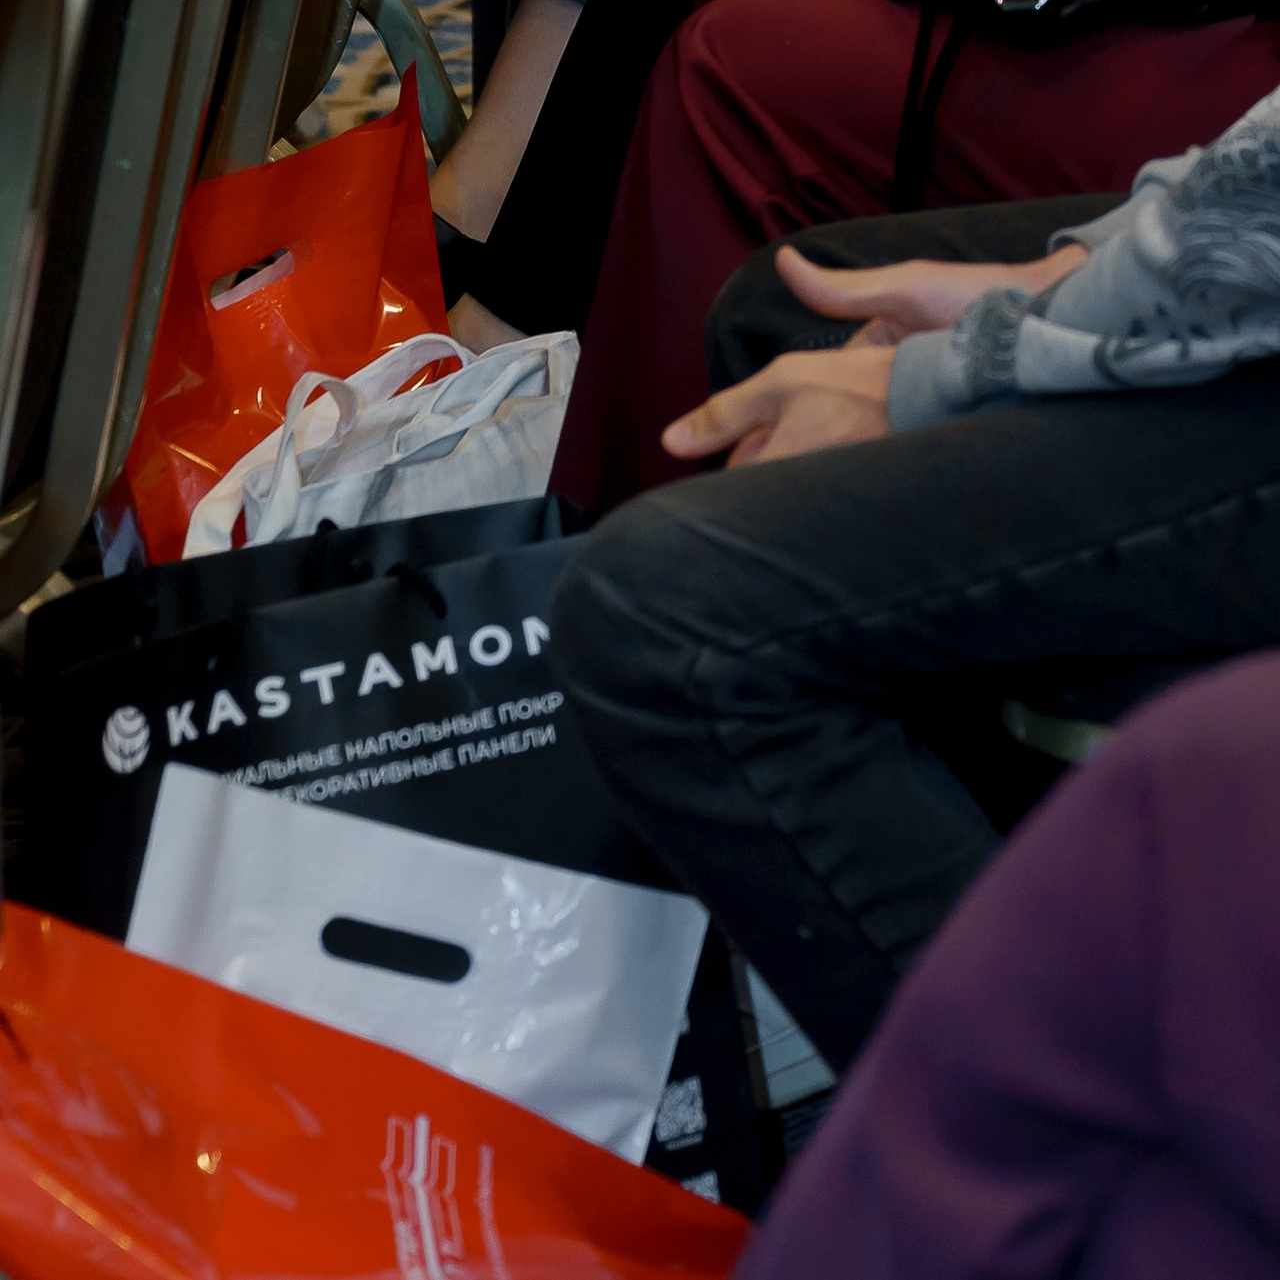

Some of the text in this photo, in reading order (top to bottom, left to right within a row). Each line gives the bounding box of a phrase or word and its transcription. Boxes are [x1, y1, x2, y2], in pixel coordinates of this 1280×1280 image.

[276, 724, 556, 804] ЕКОРАТИВНЫЕ ПАНЕЛИ
[345, 706, 496, 762] НАПОЛЬНЫЕ
